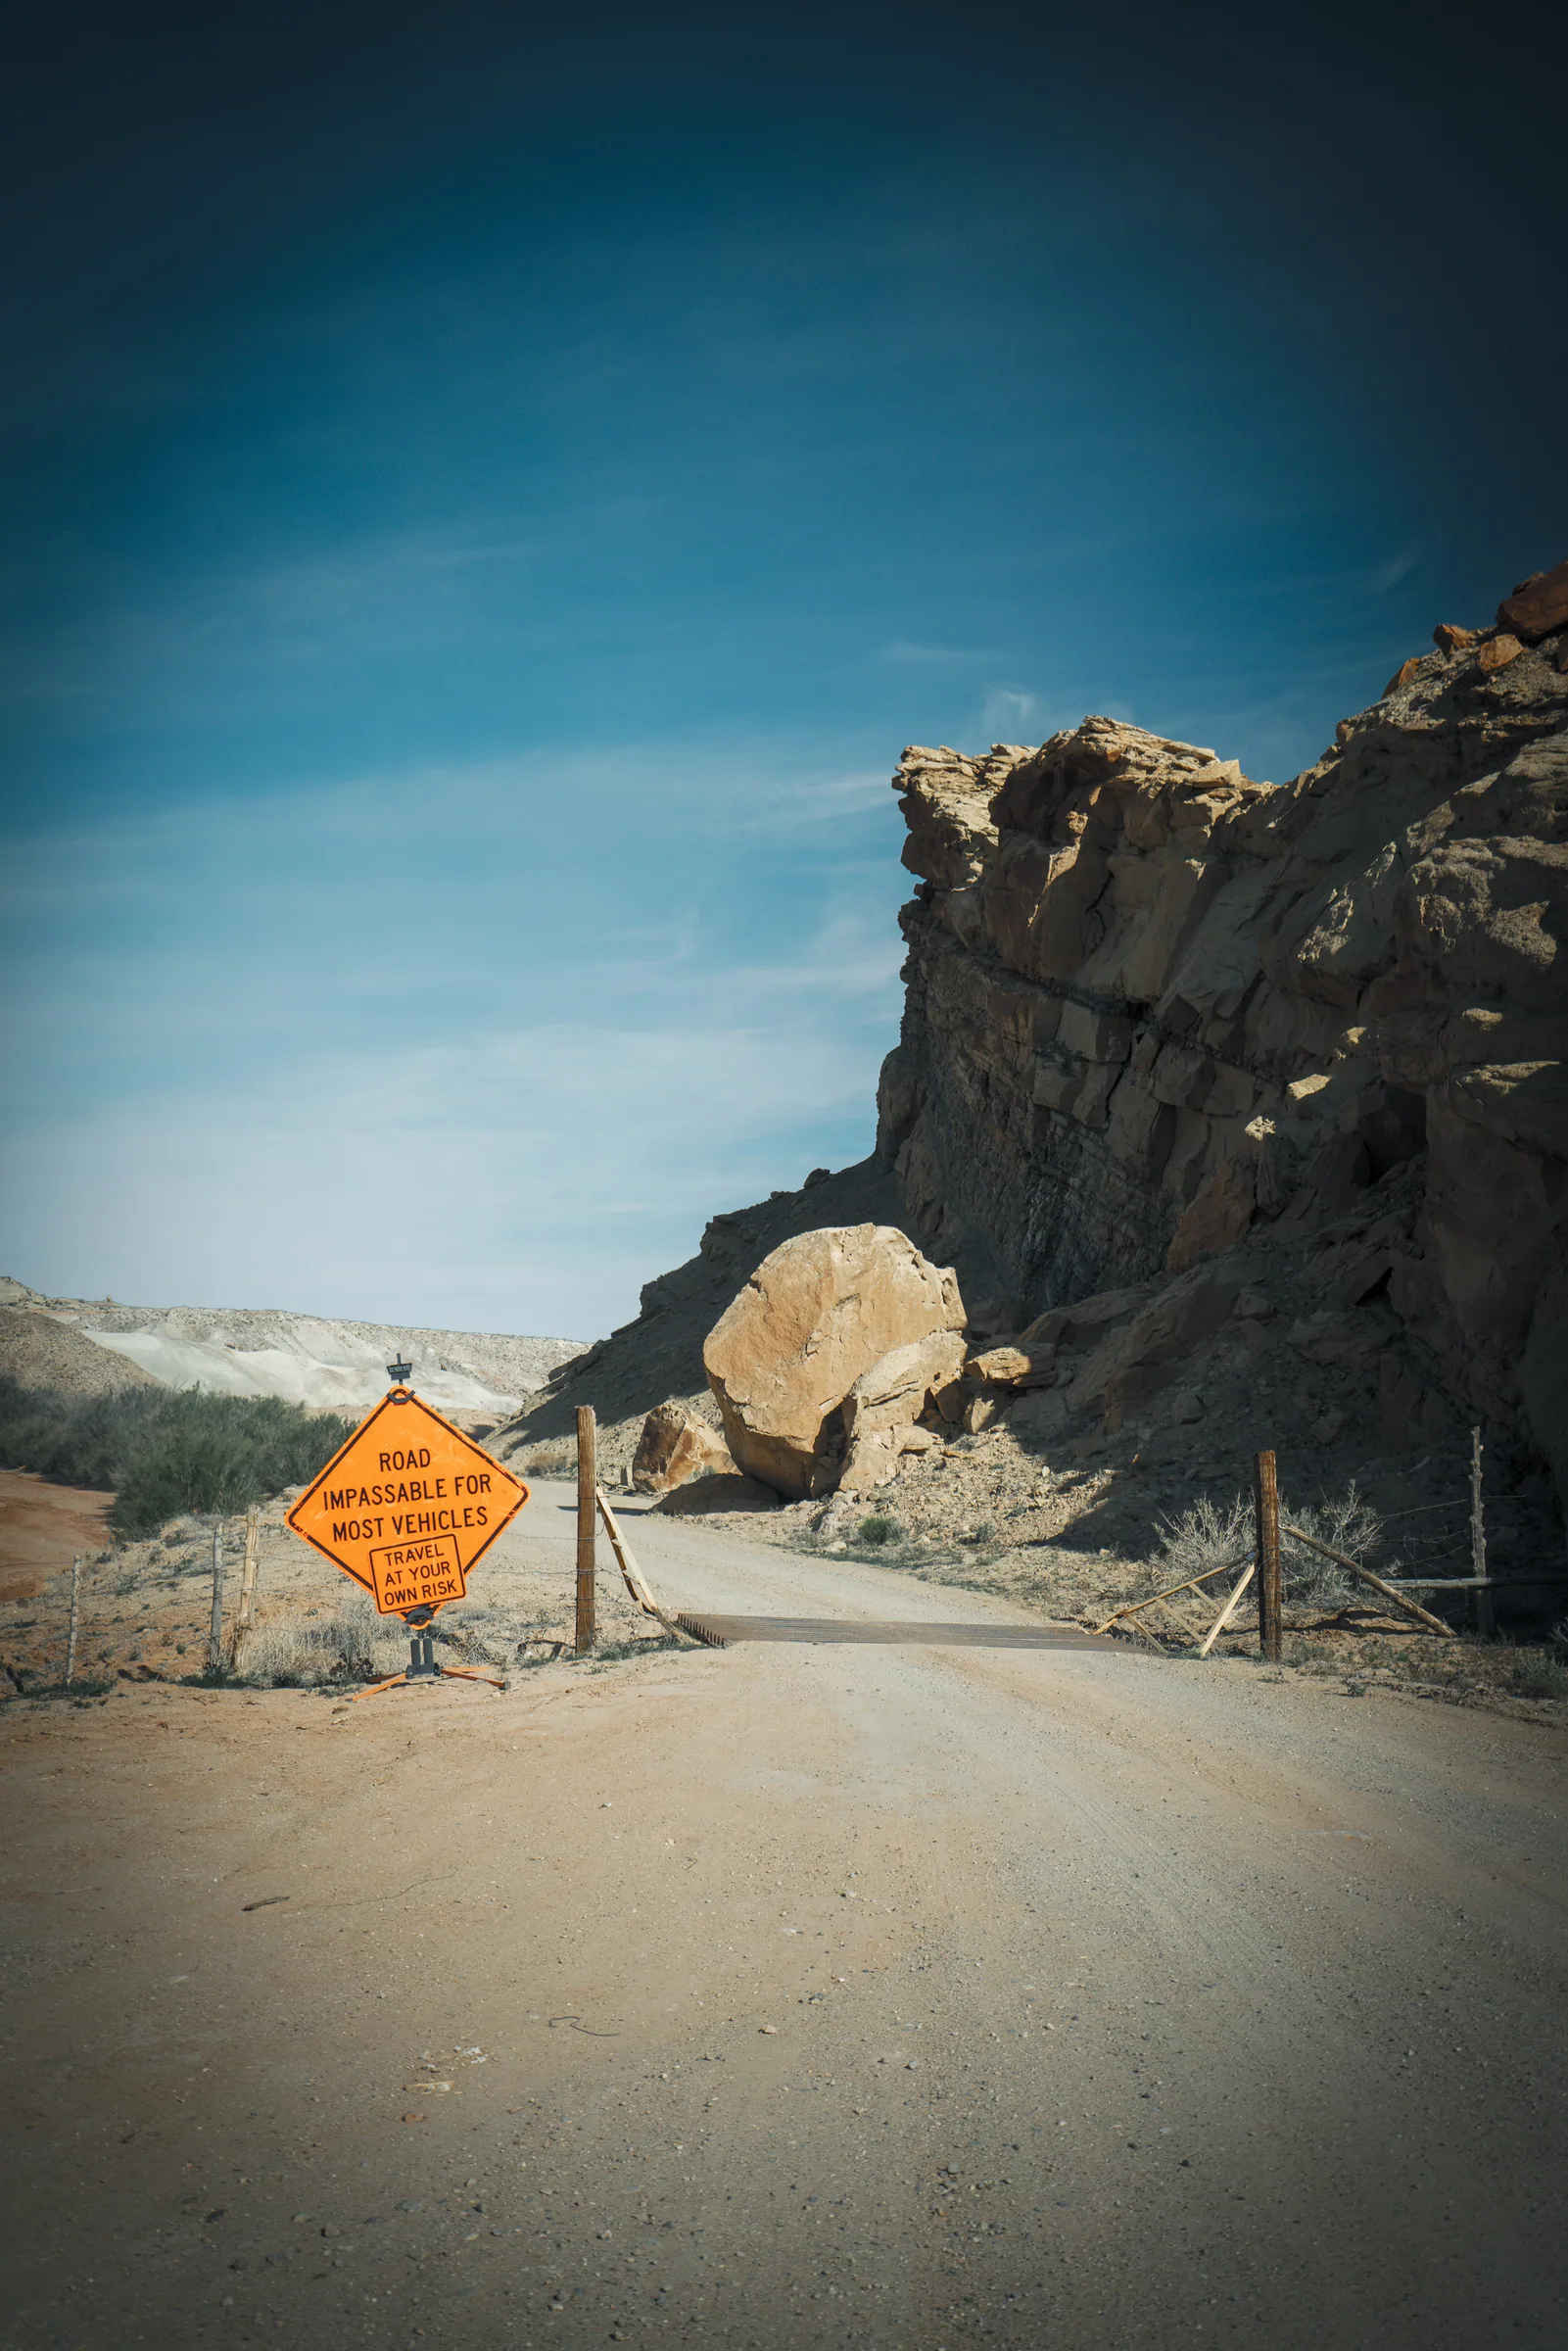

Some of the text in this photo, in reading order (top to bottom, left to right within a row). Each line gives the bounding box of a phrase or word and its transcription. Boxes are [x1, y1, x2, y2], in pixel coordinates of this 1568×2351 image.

[380, 1449, 431, 1471] ROAD
[324, 1474, 492, 1511] IMPASSABLE FOR
[333, 1507, 488, 1542] MOST VEHICLES
[384, 1544, 445, 1566] TRAVEL
[385, 1561, 451, 1587] AT YOUR
[385, 1579, 457, 1606] OWN RISK
